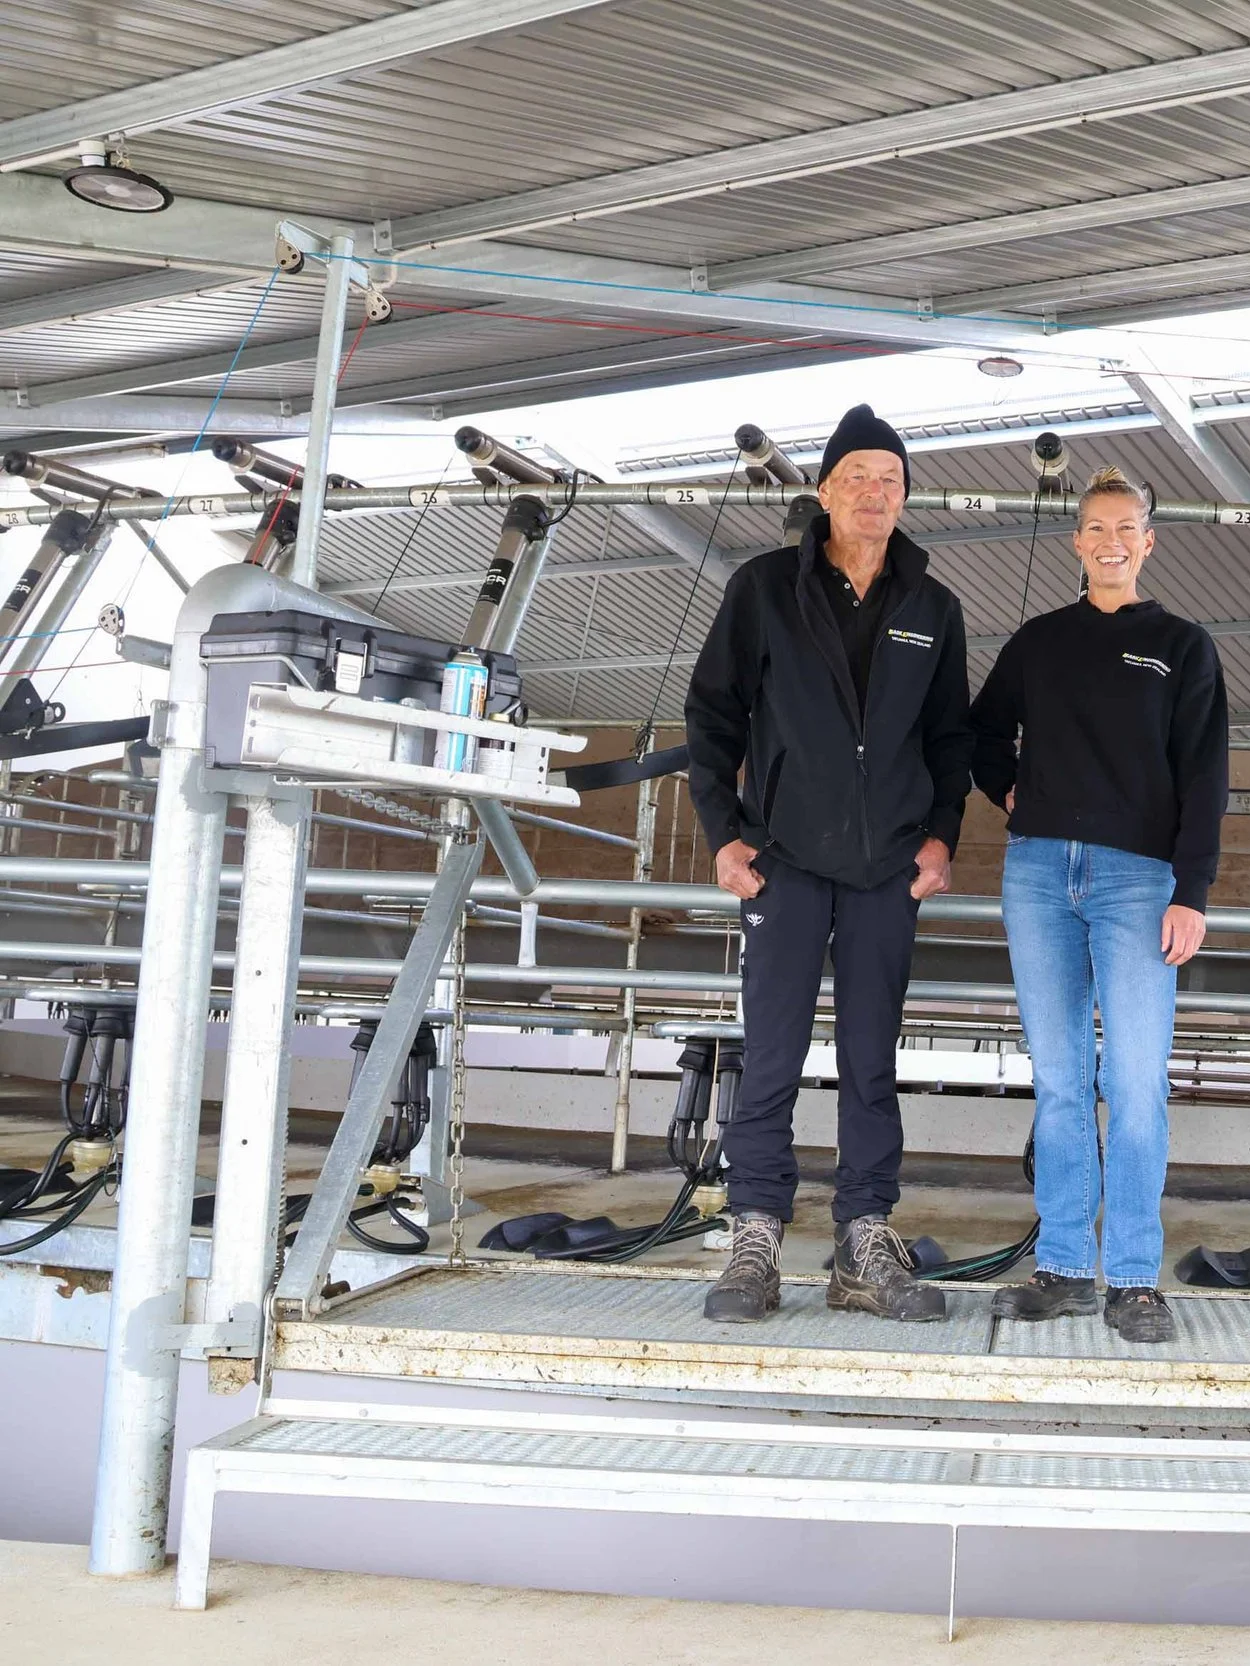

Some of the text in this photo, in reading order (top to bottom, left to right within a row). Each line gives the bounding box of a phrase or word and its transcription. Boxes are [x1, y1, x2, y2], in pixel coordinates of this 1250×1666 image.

[421, 491, 438, 504] 26
[676, 490, 694, 503] 25
[200, 500, 213, 512] 27
[963, 497, 982, 510] 24
[6, 513, 19, 525] 28
[487, 574, 507, 586] CR
